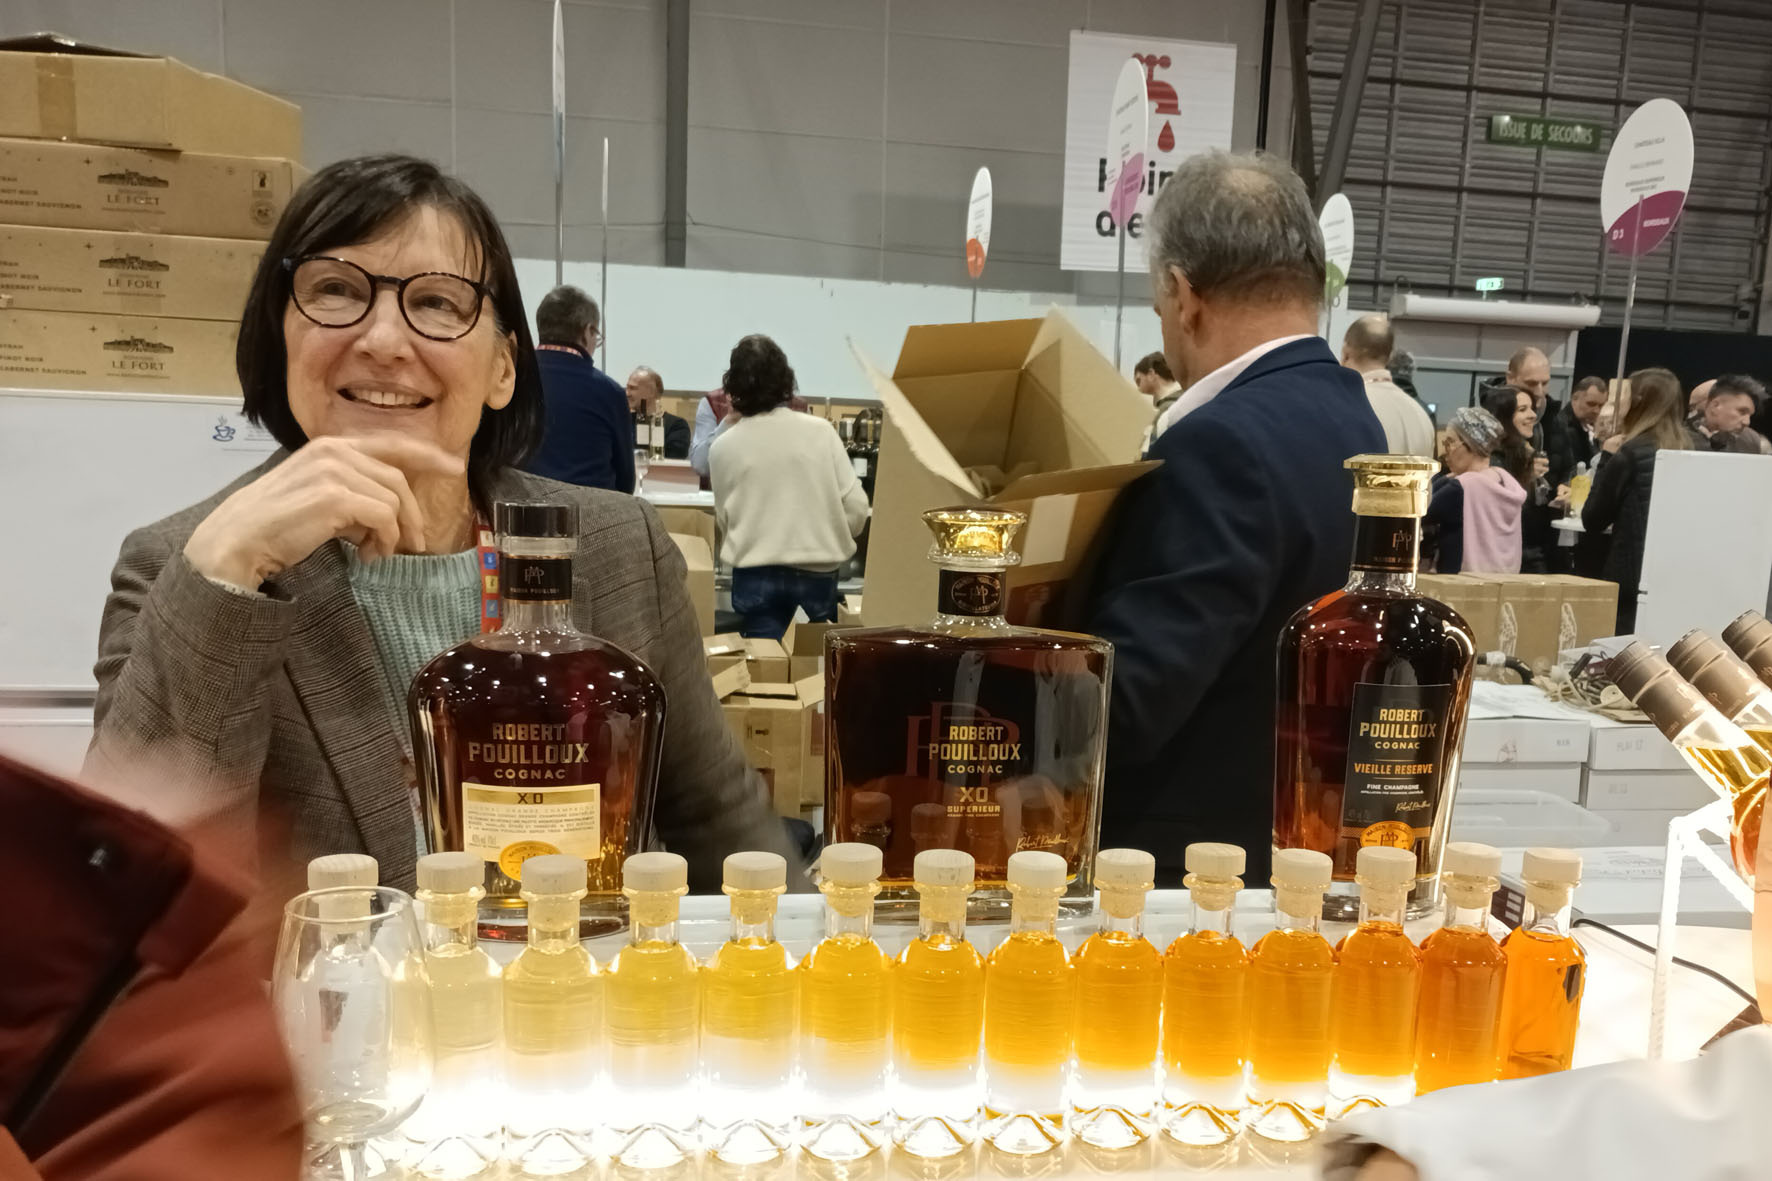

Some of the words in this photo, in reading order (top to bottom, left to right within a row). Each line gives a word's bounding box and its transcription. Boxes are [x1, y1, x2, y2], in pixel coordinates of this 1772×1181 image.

[1531, 123, 1544, 140] DE
[1547, 124, 1593, 144] SECOURS
[107, 194, 121, 203] LE
[127, 196, 160, 206] FORT
[108, 278, 120, 288] LE
[128, 279, 161, 289] FORT
[112, 361, 125, 370] LE
[131, 361, 164, 371] FORT
[1379, 708, 1425, 722] ROBERT
[492, 722, 566, 741] ROBERT
[949, 725, 1005, 741] ROBERT
[1359, 722, 1437, 739] POUILLOUX
[928, 743, 1022, 761] POUILLOUX
[1374, 741, 1421, 750] COGNAC
[468, 741, 590, 765] POUILLOUX
[493, 768, 567, 780] COGNAC
[947, 764, 1004, 774] COGNAC
[1353, 762, 1393, 775] VIEILLE
[1394, 763, 1433, 775] RESERVE
[517, 792, 544, 805] XO
[959, 786, 990, 803] XO
[946, 805, 1001, 813] SUPERIEUR
